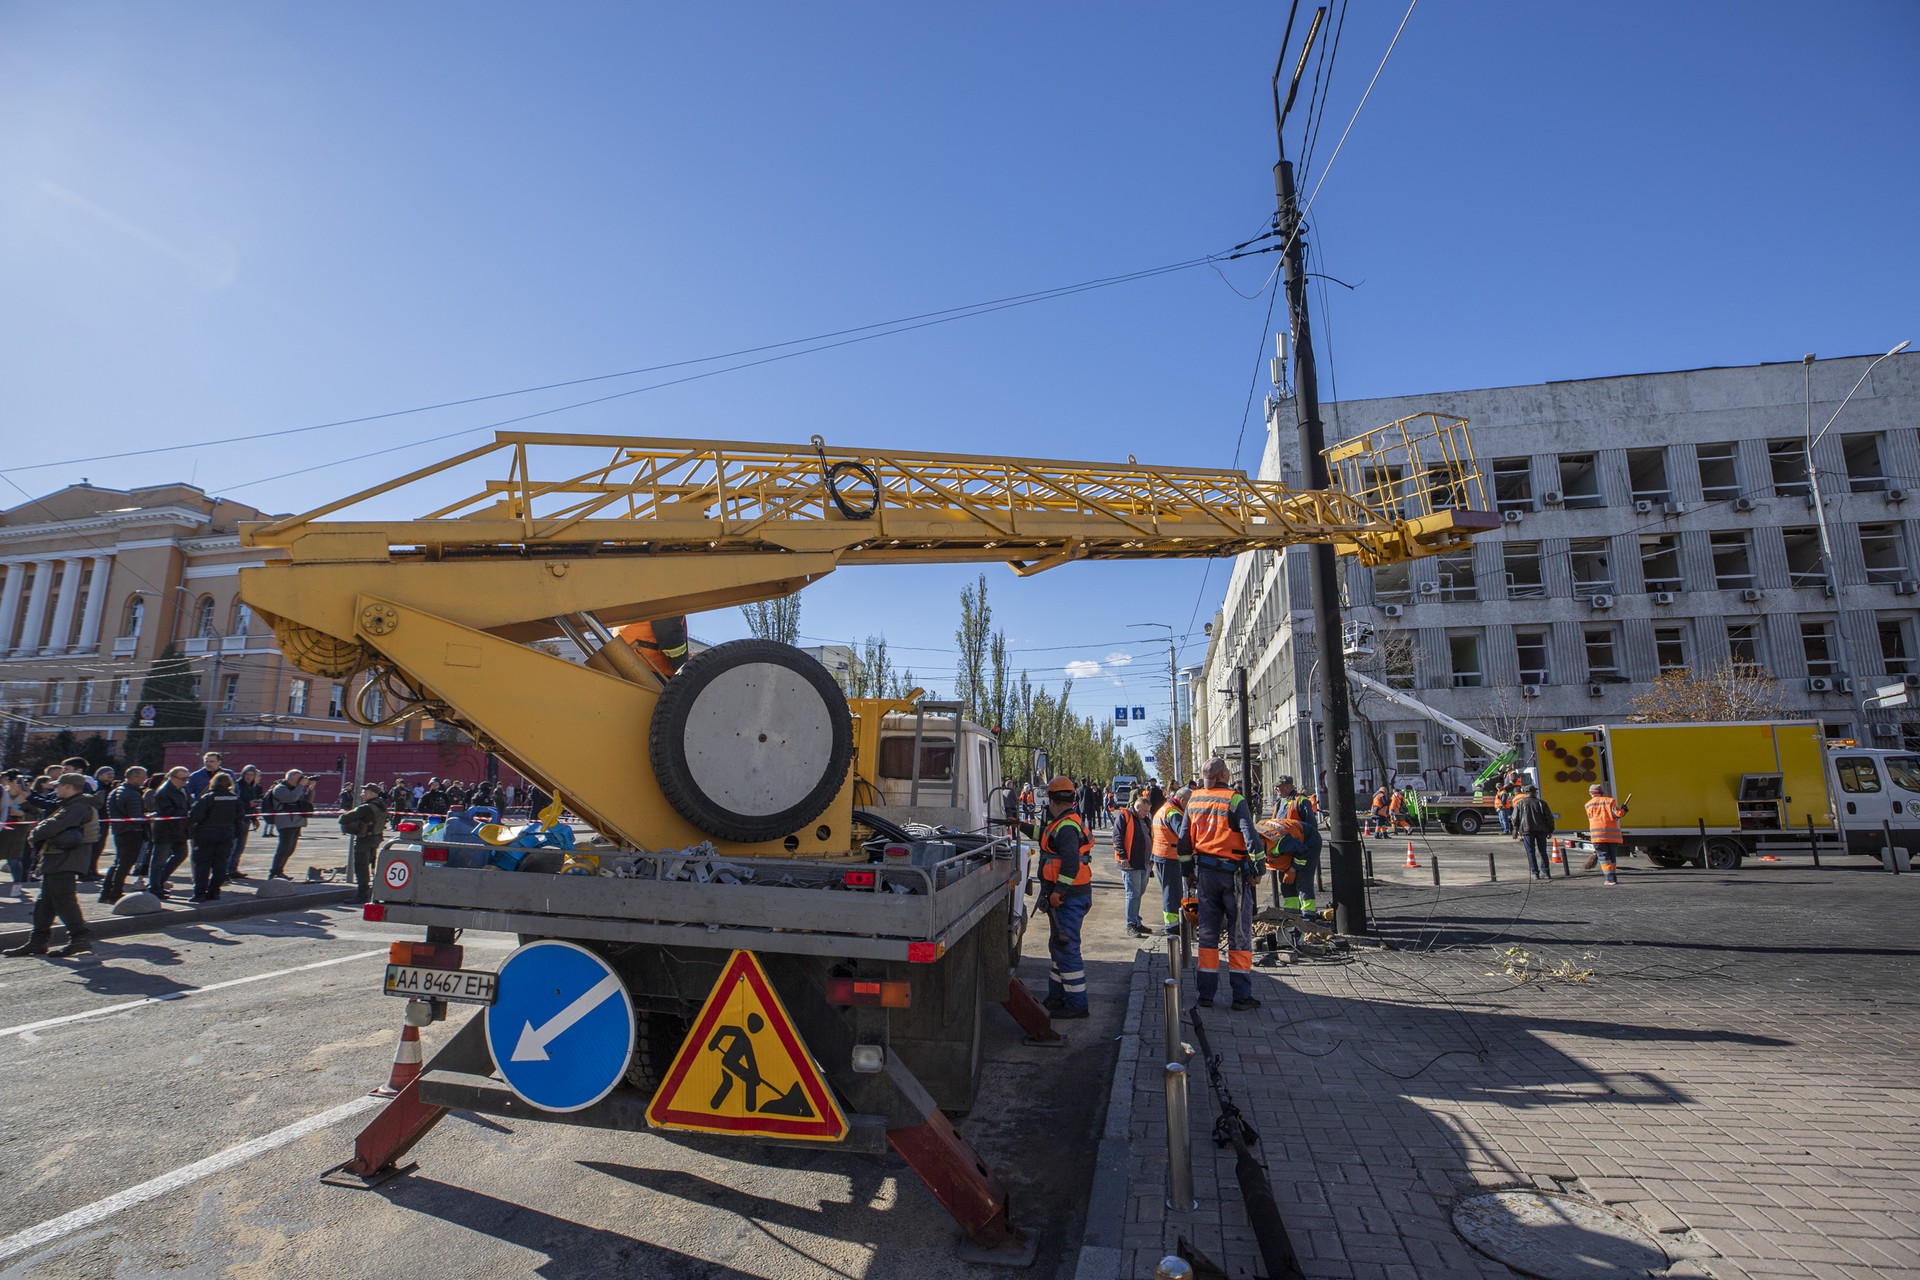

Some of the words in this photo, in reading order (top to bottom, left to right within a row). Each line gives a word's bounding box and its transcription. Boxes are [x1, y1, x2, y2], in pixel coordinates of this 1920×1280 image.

[389, 867, 406, 881] 50
[396, 969, 419, 990] AA
[423, 972, 462, 993] 8467
[465, 976, 491, 996] EH
